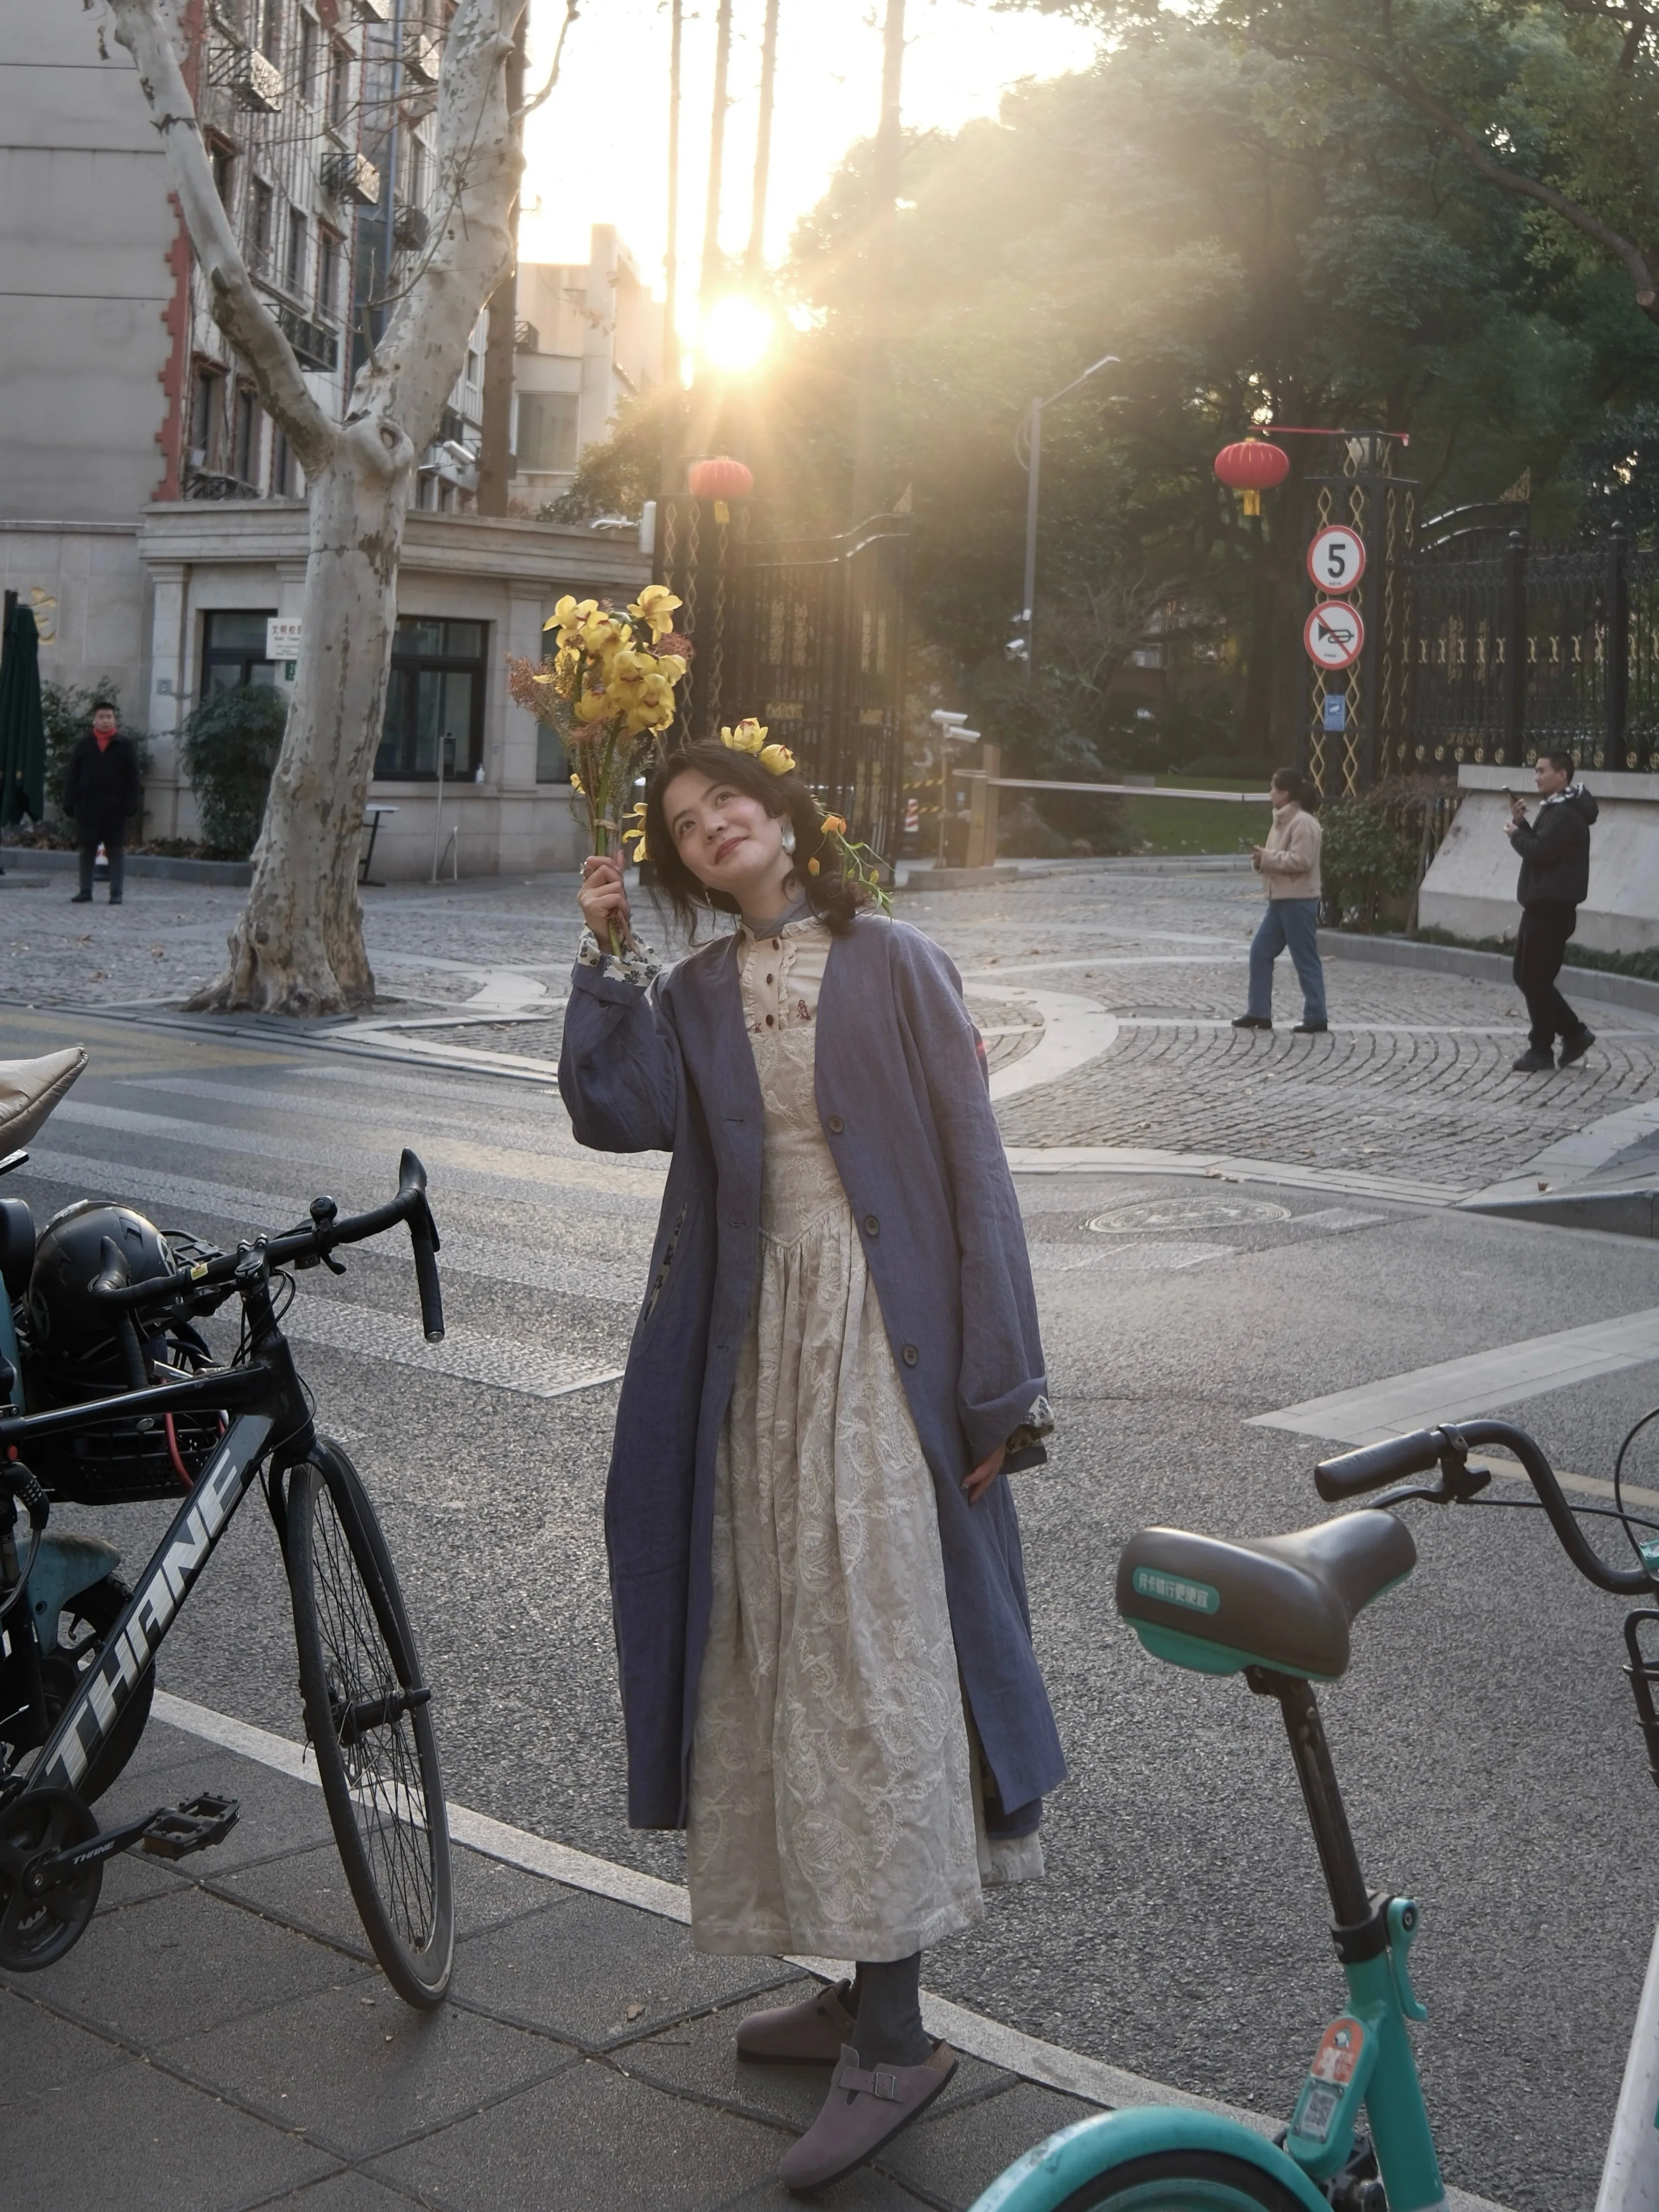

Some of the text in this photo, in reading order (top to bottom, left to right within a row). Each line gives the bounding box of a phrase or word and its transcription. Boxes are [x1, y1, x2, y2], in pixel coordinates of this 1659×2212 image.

[1327, 544, 1345, 578] 5
[45, 1447, 243, 1790] THANE
[72, 1839, 116, 1865] THANE
